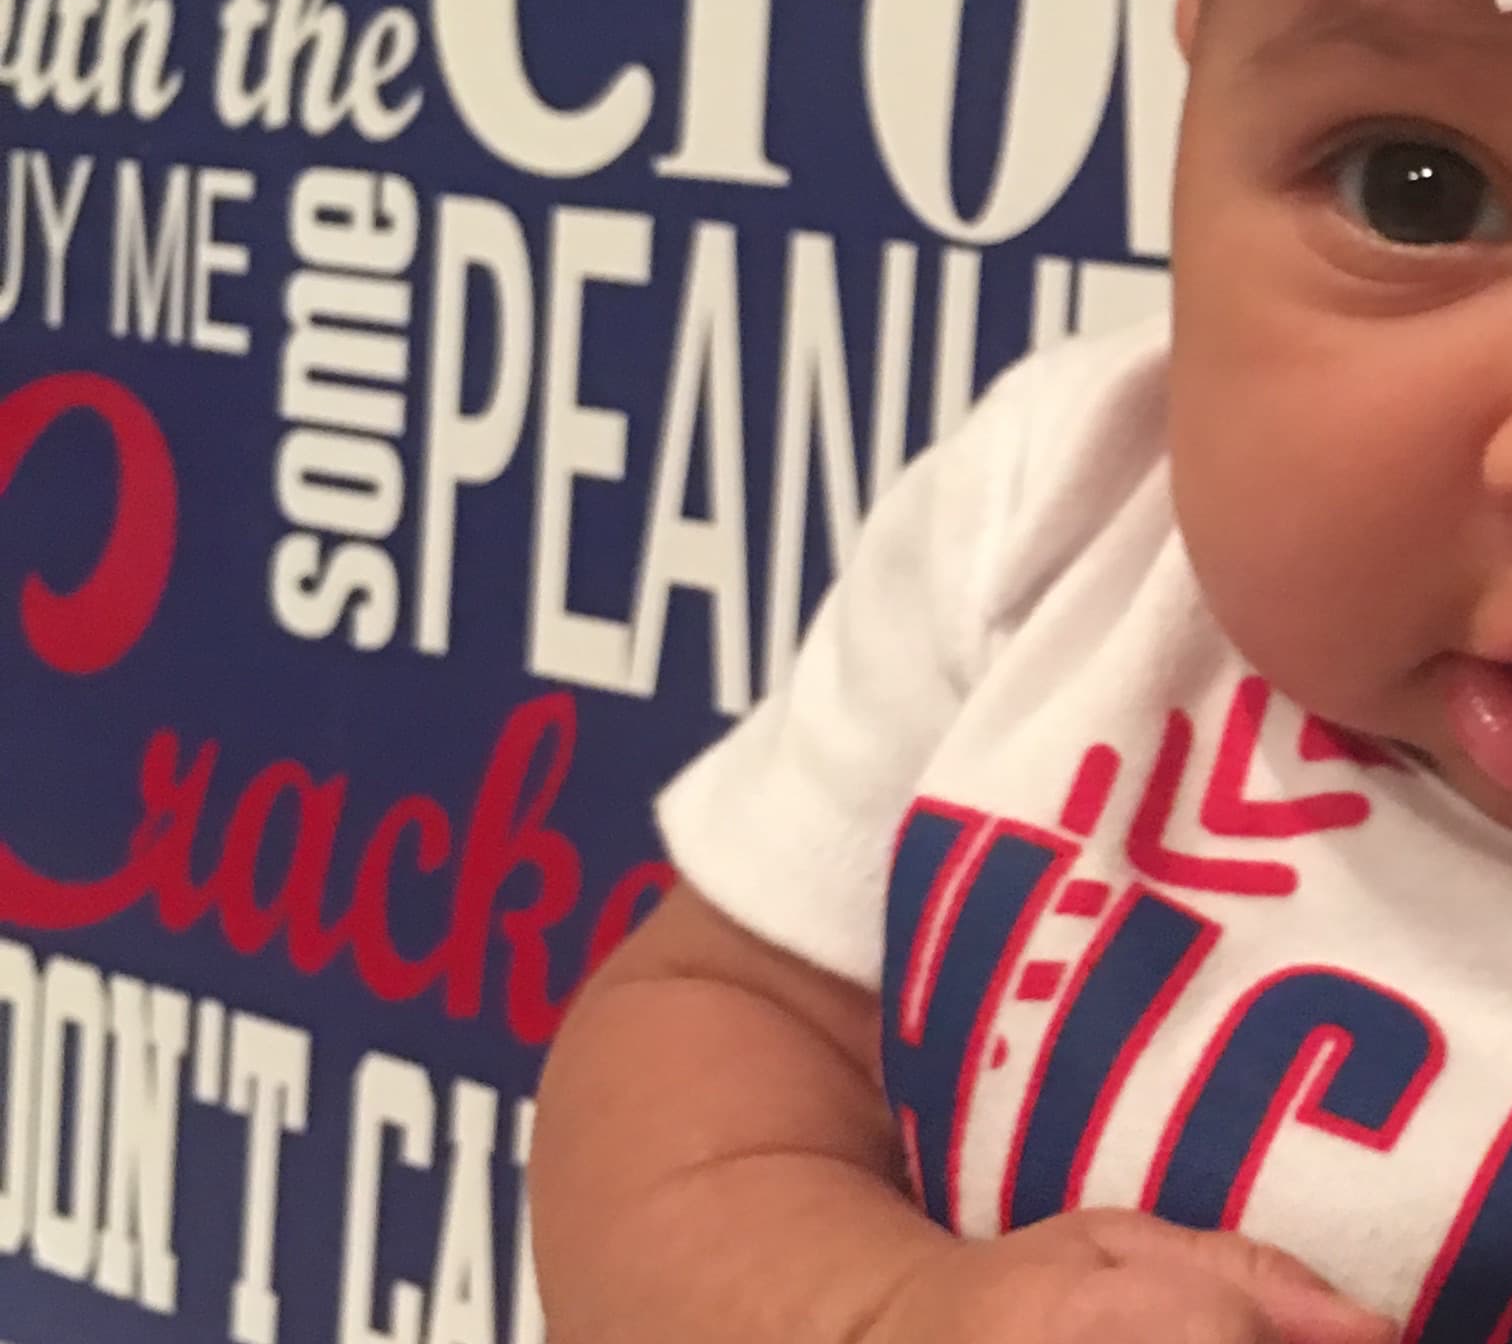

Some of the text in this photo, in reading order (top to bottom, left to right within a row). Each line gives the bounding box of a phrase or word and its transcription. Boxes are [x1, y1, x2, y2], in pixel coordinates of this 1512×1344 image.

[110, 159, 257, 355] ME
[270, 166, 421, 652] some
[416, 193, 1172, 718] PEAN
